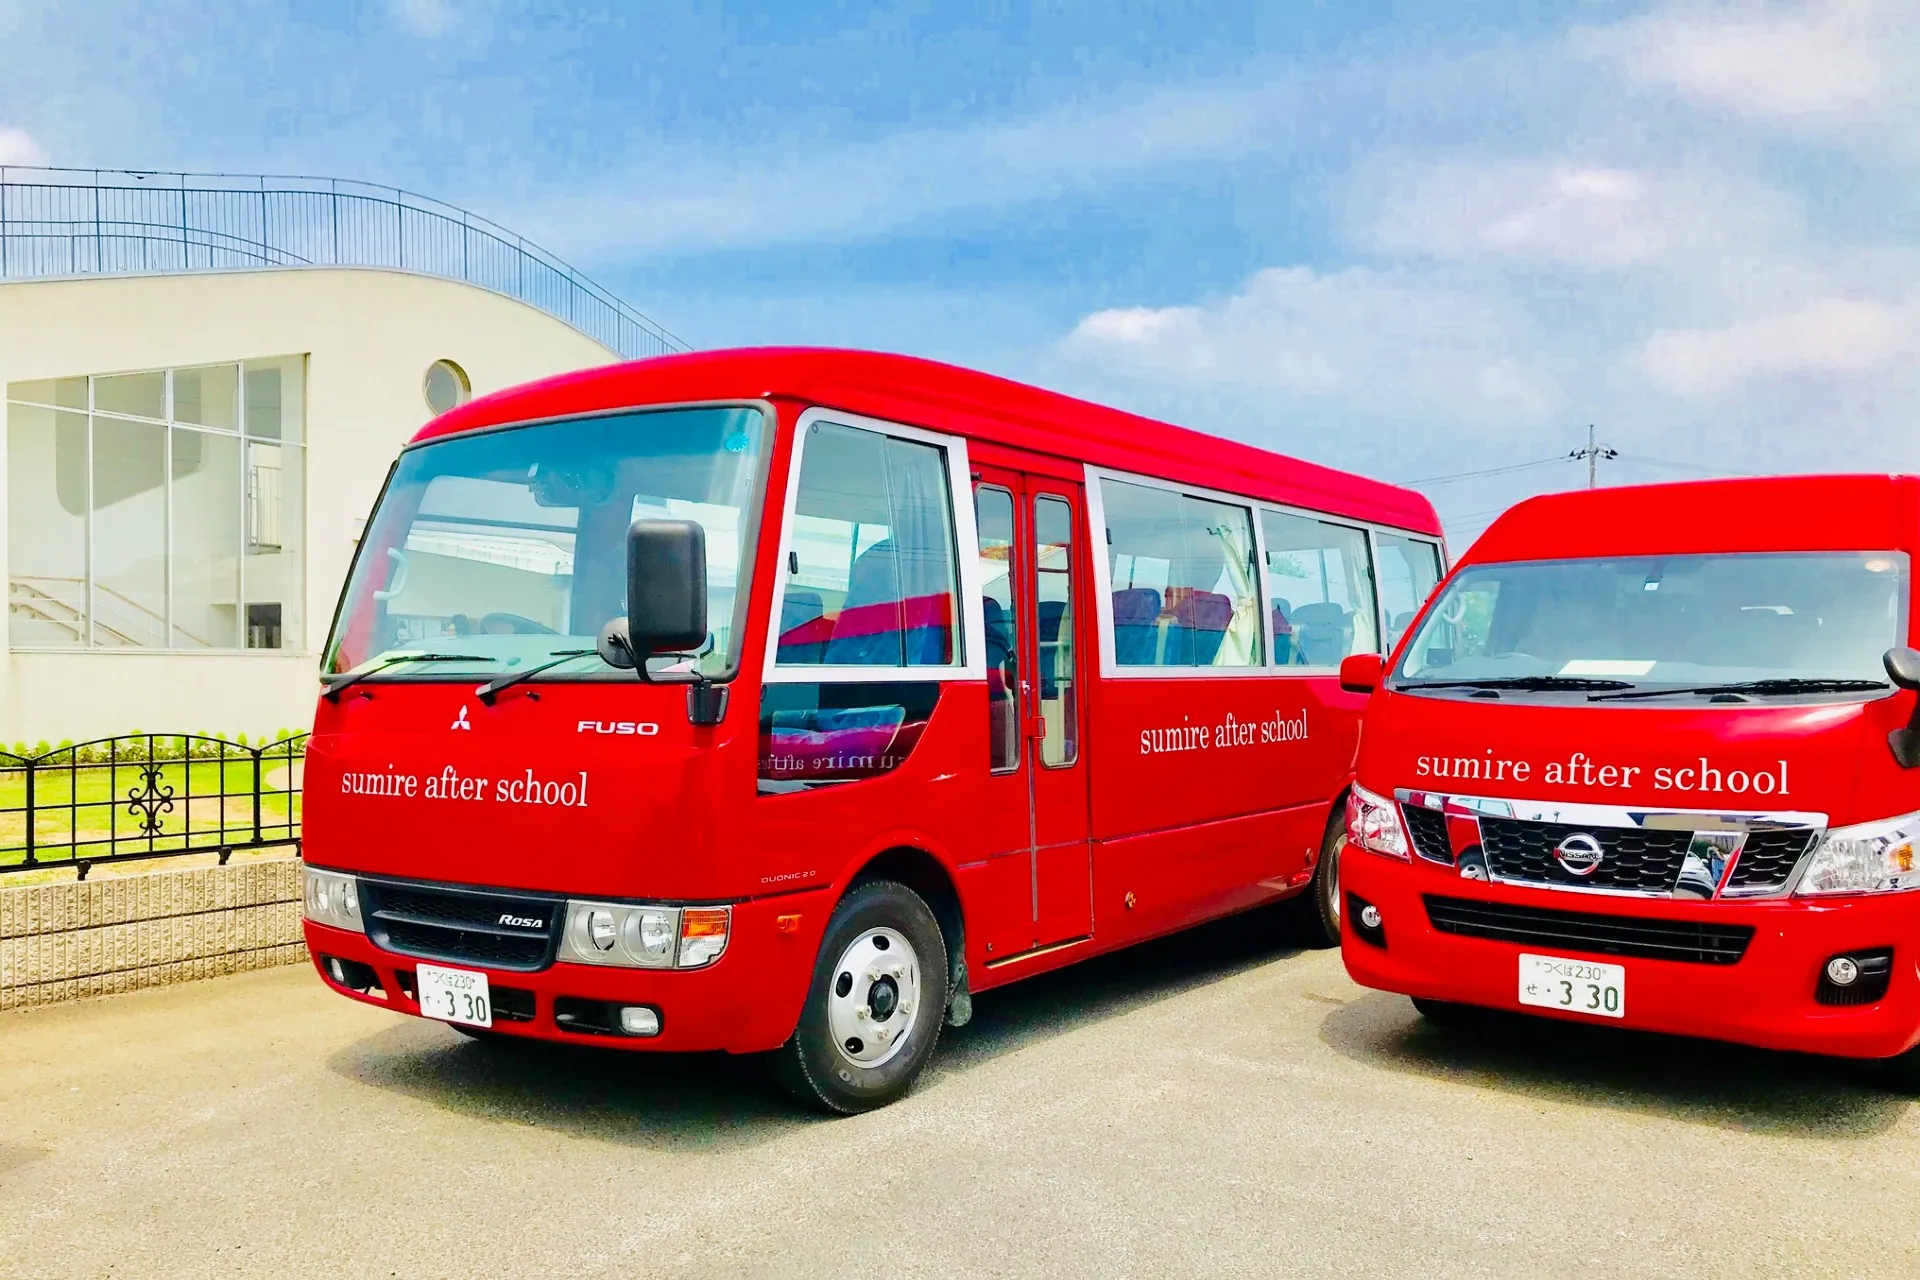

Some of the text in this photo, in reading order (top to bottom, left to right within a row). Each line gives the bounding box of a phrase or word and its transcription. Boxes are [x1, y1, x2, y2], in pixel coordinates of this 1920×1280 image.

[577, 720, 659, 736] FUSO
[1140, 708, 1308, 755] sumire after school
[341, 763, 588, 807] sumire after school
[1416, 748, 1790, 796] sumire after school
[1558, 850, 1599, 861] NISSAN
[761, 872, 801, 884] DUONIC
